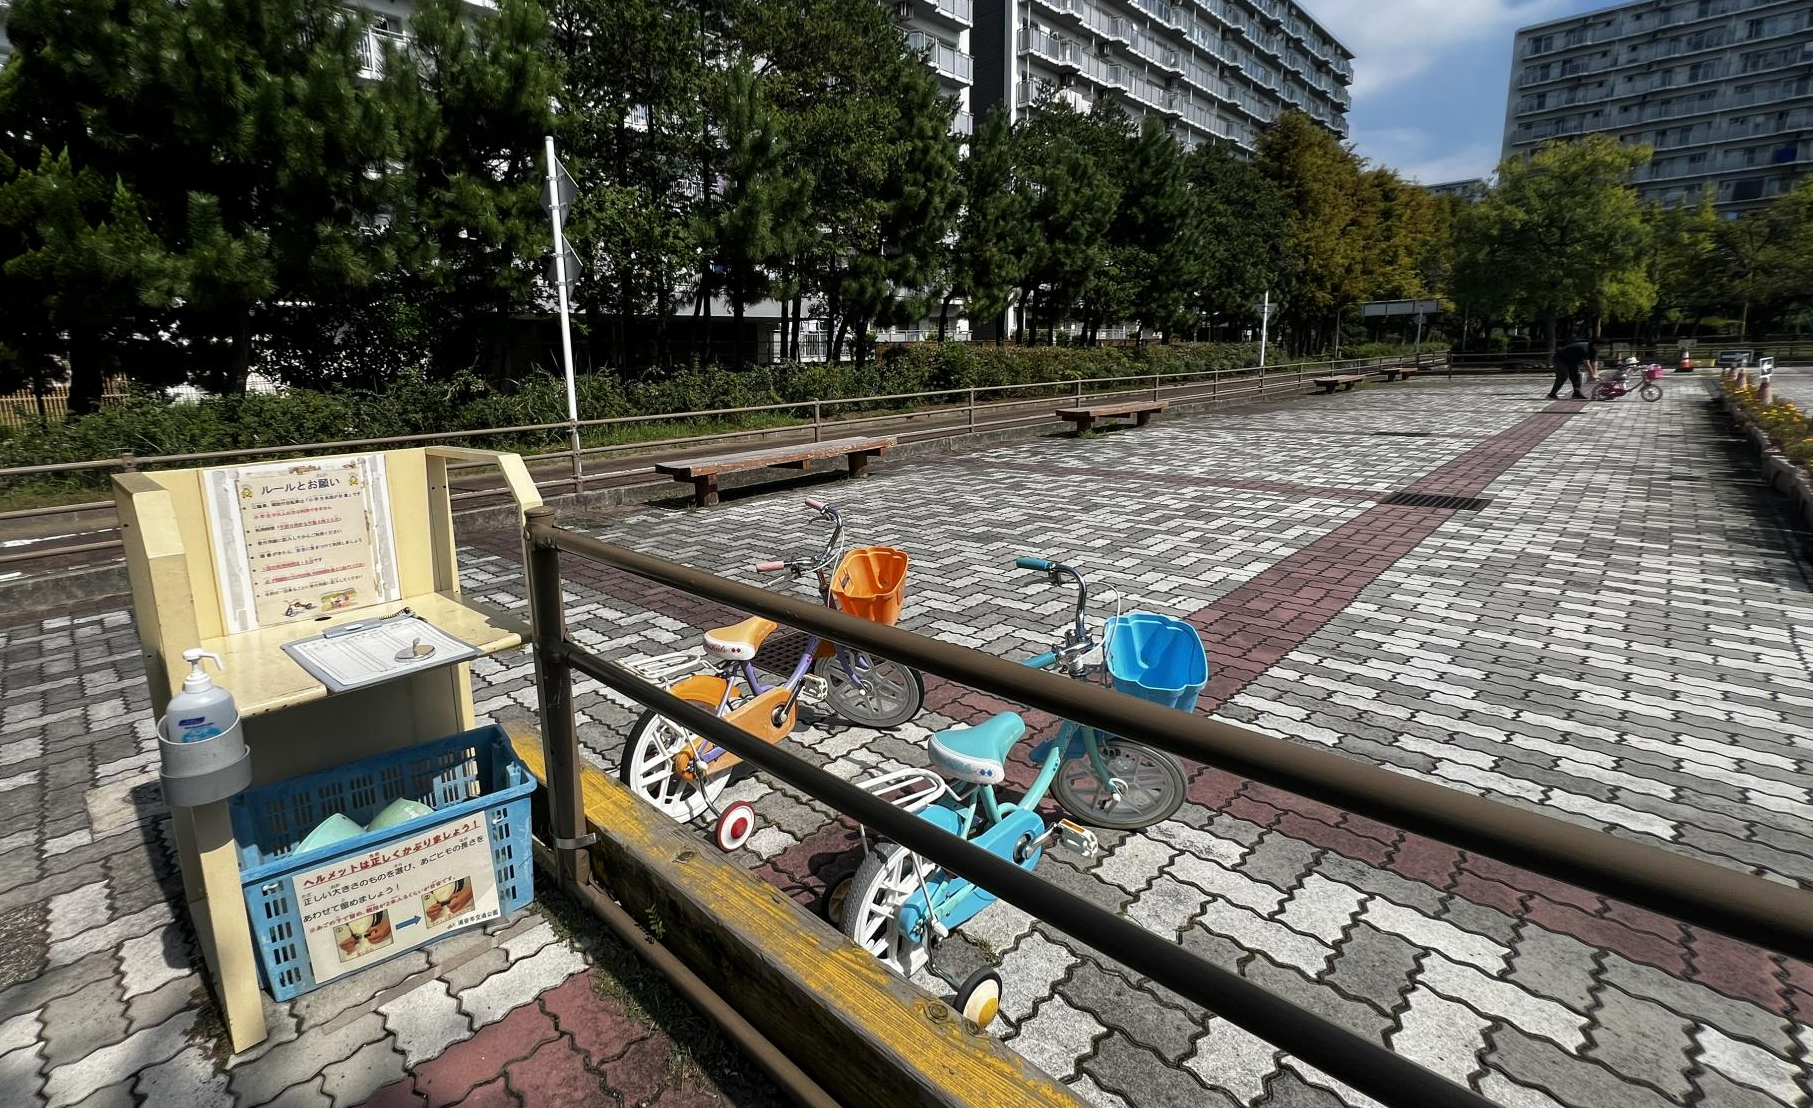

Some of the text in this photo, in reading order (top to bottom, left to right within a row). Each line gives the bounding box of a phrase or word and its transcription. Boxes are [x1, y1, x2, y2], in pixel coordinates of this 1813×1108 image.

[261, 478, 340, 495] ルールとお願い
[303, 820, 478, 887] ヘルメットは正しくかぶりましょう！
[303, 835, 484, 906] 正しい大きさのものを選び、あごヒモの長さを
